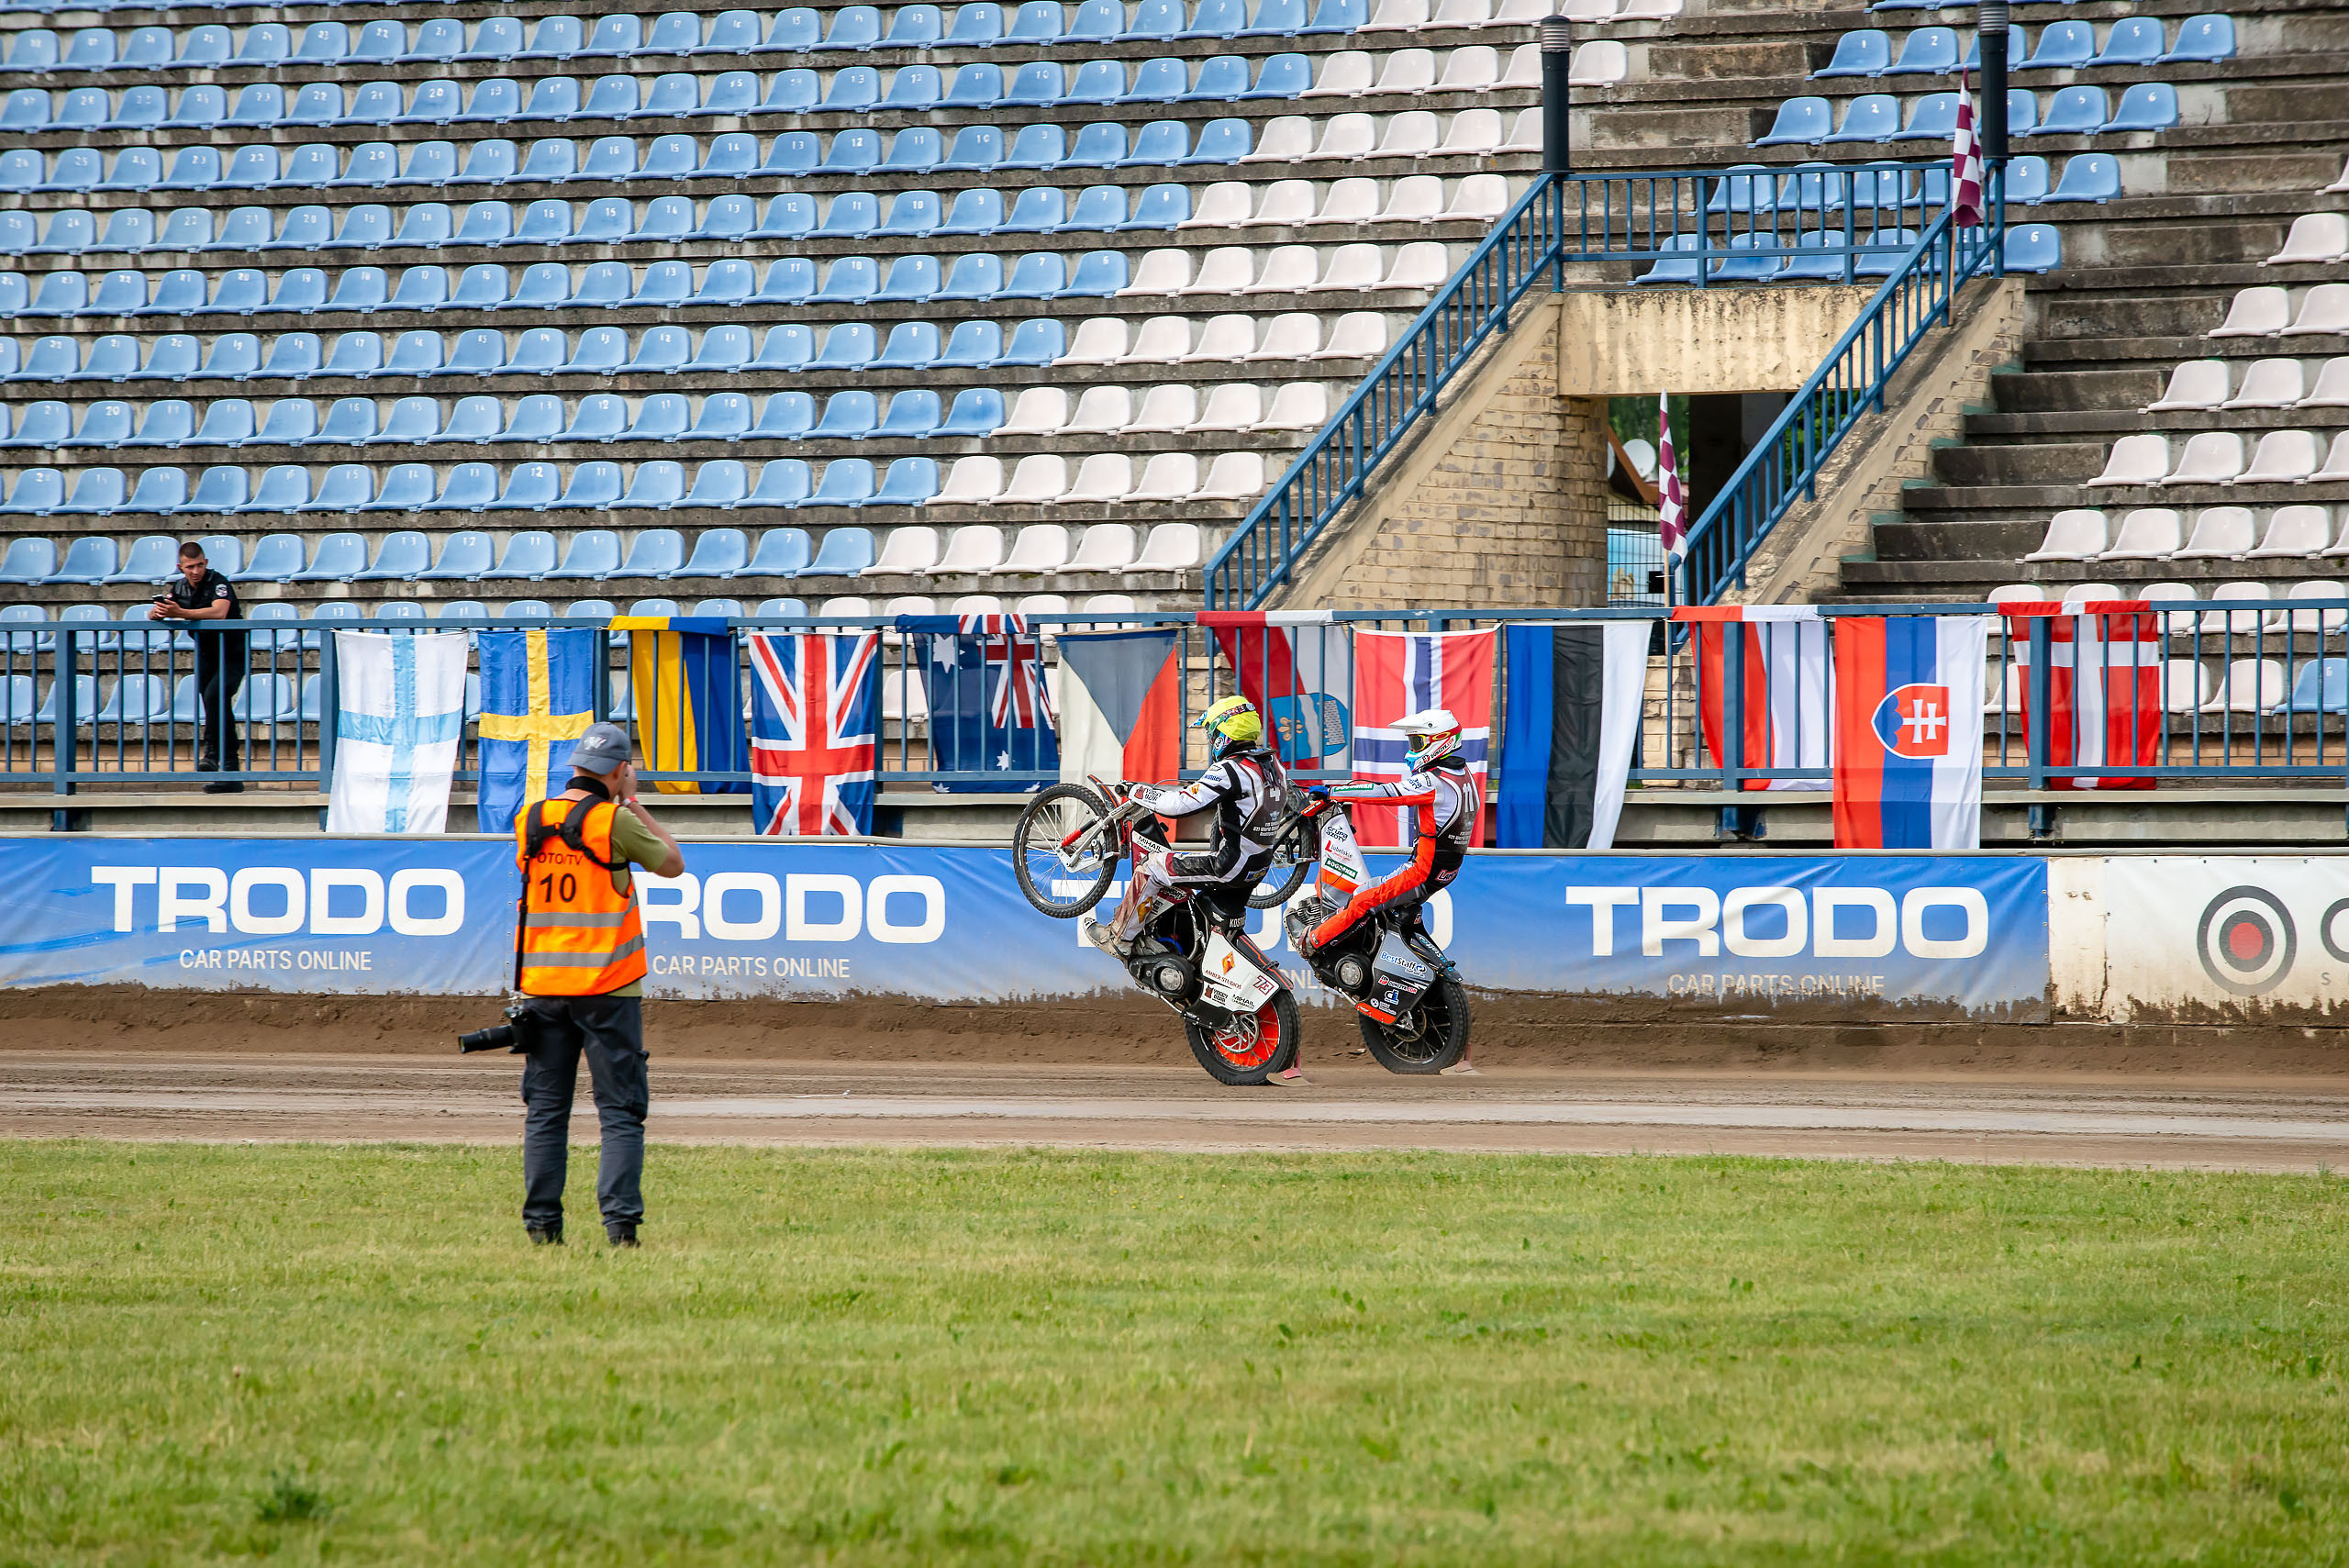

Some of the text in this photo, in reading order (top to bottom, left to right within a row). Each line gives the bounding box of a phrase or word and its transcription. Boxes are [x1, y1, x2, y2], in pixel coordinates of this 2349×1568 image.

[1036, 9, 1048, 18] 11
[1099, 6, 1110, 16] 10
[912, 13, 924, 24] 13
[317, 29, 329, 41] 23
[375, 27, 389, 39] 22
[435, 26, 447, 37] 21
[1930, 35, 1939, 47] 2
[1284, 61, 1293, 71] 6
[851, 74, 865, 84] 13
[1036, 70, 1049, 79] 10
[729, 78, 743, 88] 15
[313, 90, 328, 102] 22
[370, 90, 384, 100] 21
[429, 87, 445, 99] 20
[2147, 91, 2157, 103] 6
[1871, 103, 1880, 115] 2
[1939, 100, 1946, 111] 3
[1163, 126, 1171, 137] 7
[1223, 127, 1231, 137] 6
[851, 137, 864, 148] 12
[913, 135, 925, 146] 11
[975, 133, 991, 144] 10
[549, 144, 561, 155] 17
[608, 145, 620, 155] 16
[669, 142, 680, 153] 15
[791, 140, 804, 150] 13
[191, 154, 206, 165] 23
[249, 152, 265, 162] 22
[310, 151, 324, 162] 21
[369, 150, 386, 161] 20
[977, 195, 985, 206] 9
[1040, 191, 1048, 202] 8
[1100, 191, 1108, 202] 7
[728, 203, 740, 214] 13
[786, 201, 799, 213] 12
[852, 200, 863, 211] 11
[912, 200, 925, 210] 10
[482, 210, 493, 221] 17
[543, 208, 555, 219] 16
[605, 206, 617, 217] 15
[2030, 228, 2041, 243] 6
[791, 262, 801, 272] 11
[851, 260, 863, 271] 10
[916, 260, 924, 272] 9
[1039, 256, 1046, 267] 7
[665, 266, 676, 277] 13
[118, 273, 132, 284] 22
[179, 272, 192, 283] 21
[725, 332, 735, 342] 11
[786, 328, 798, 339] 10
[851, 327, 860, 337] 9
[975, 327, 983, 337] 7
[355, 336, 365, 348] 17
[415, 337, 424, 348] 16
[477, 333, 488, 344] 15
[600, 332, 610, 345] 13
[660, 333, 672, 343] 12
[597, 398, 610, 410] 12
[661, 398, 672, 410] 11
[724, 397, 738, 408] 10
[105, 405, 121, 417] 20
[530, 465, 544, 478] 12
[596, 466, 607, 477] 11
[462, 536, 477, 547] 12
[529, 536, 541, 546] 11
[785, 532, 793, 544] 7
[332, 606, 345, 619] 13
[396, 606, 410, 617] 12
[459, 606, 469, 617] 11
[1462, 782, 1475, 813] 11
[1138, 834, 1163, 852] MIHAIL
[537, 851, 584, 866] OTO/TV
[540, 873, 577, 903] 10
[91, 865, 465, 936] TRODO
[629, 871, 946, 944] RODO
[1564, 885, 1989, 959] TRODO
[178, 948, 373, 973] CAR PARTS ONLINE
[1380, 951, 1418, 973] BestStaff
[652, 954, 851, 979] CAR PARTS ONLINE
[1204, 969, 1222, 983] AMBER
[1252, 974, 1275, 996] 73
[1667, 973, 1886, 997] CAR PARTS ONLINE
